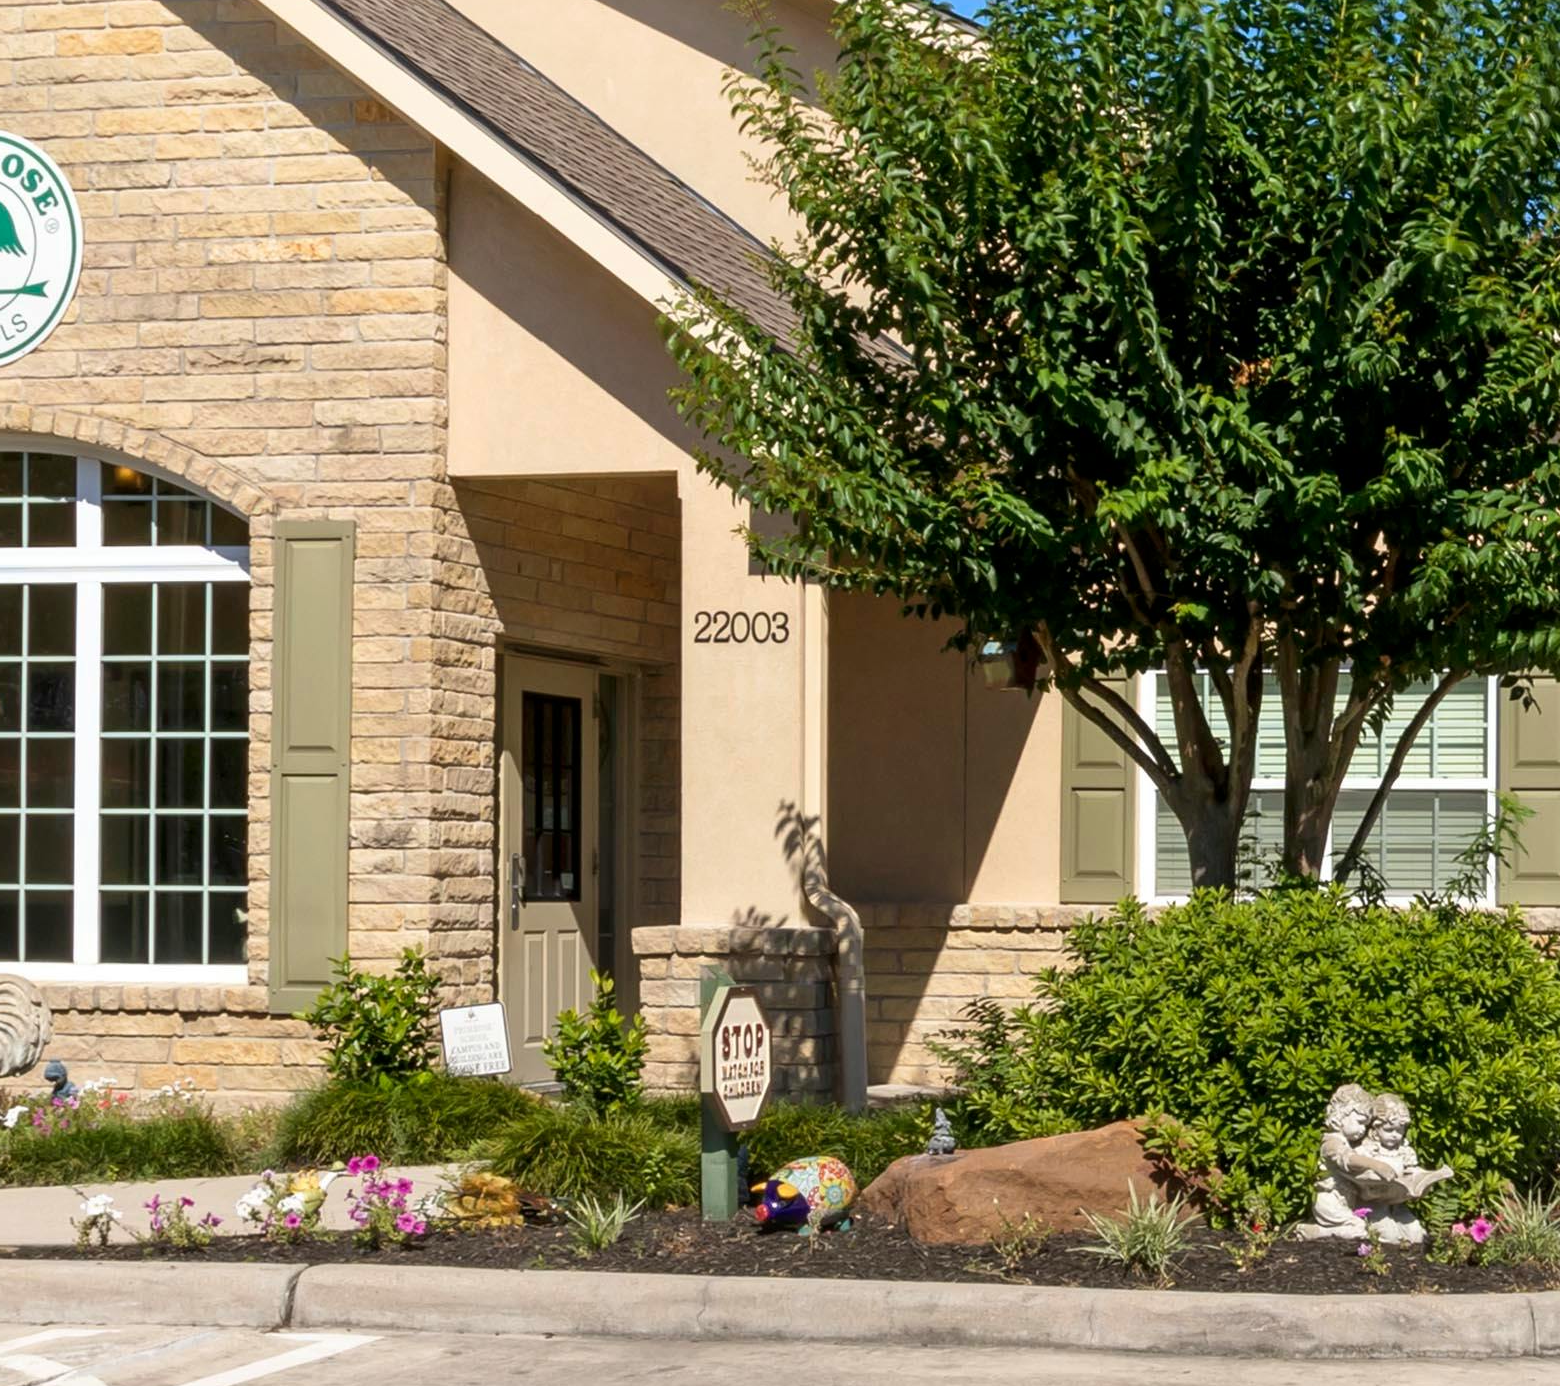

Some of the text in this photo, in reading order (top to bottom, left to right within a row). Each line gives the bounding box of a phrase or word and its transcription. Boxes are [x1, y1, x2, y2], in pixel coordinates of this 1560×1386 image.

[694, 611, 789, 643] 22003
[484, 1042, 501, 1050] AND
[722, 1023, 764, 1060] STOP
[483, 1060, 505, 1072] FREE
[722, 1060, 764, 1081] WATCH FOR
